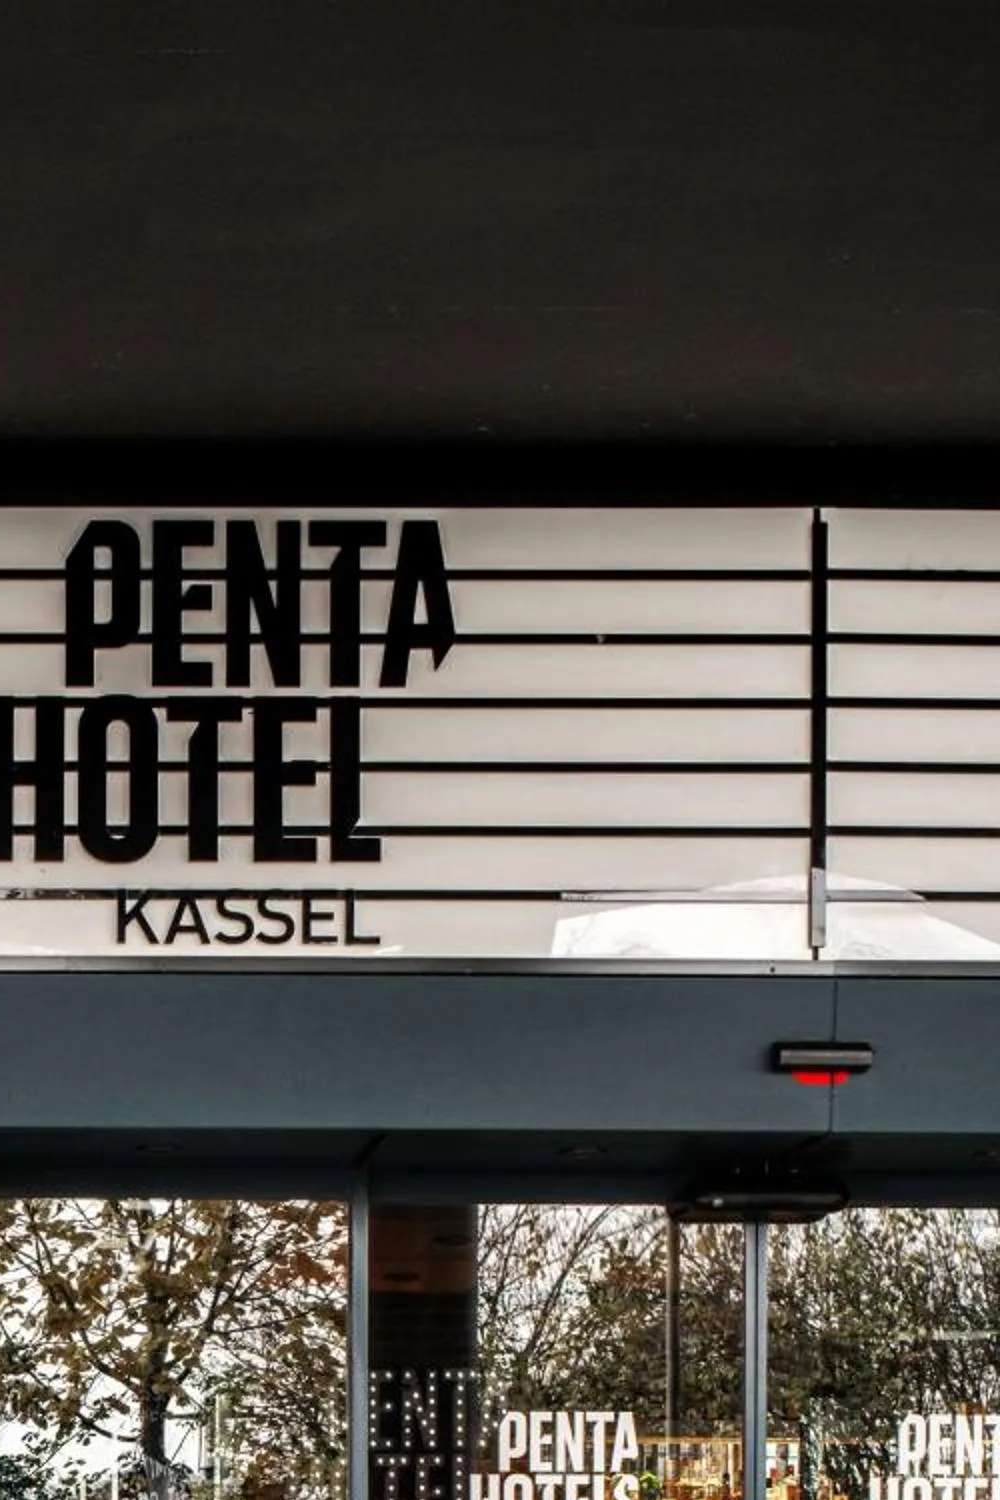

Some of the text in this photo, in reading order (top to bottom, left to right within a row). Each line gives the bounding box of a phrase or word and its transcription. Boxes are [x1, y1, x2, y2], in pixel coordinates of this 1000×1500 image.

[65, 520, 455, 688] PENTA
[117, 889, 381, 945] KASSEL
[498, 1411, 639, 1473] PENTA
